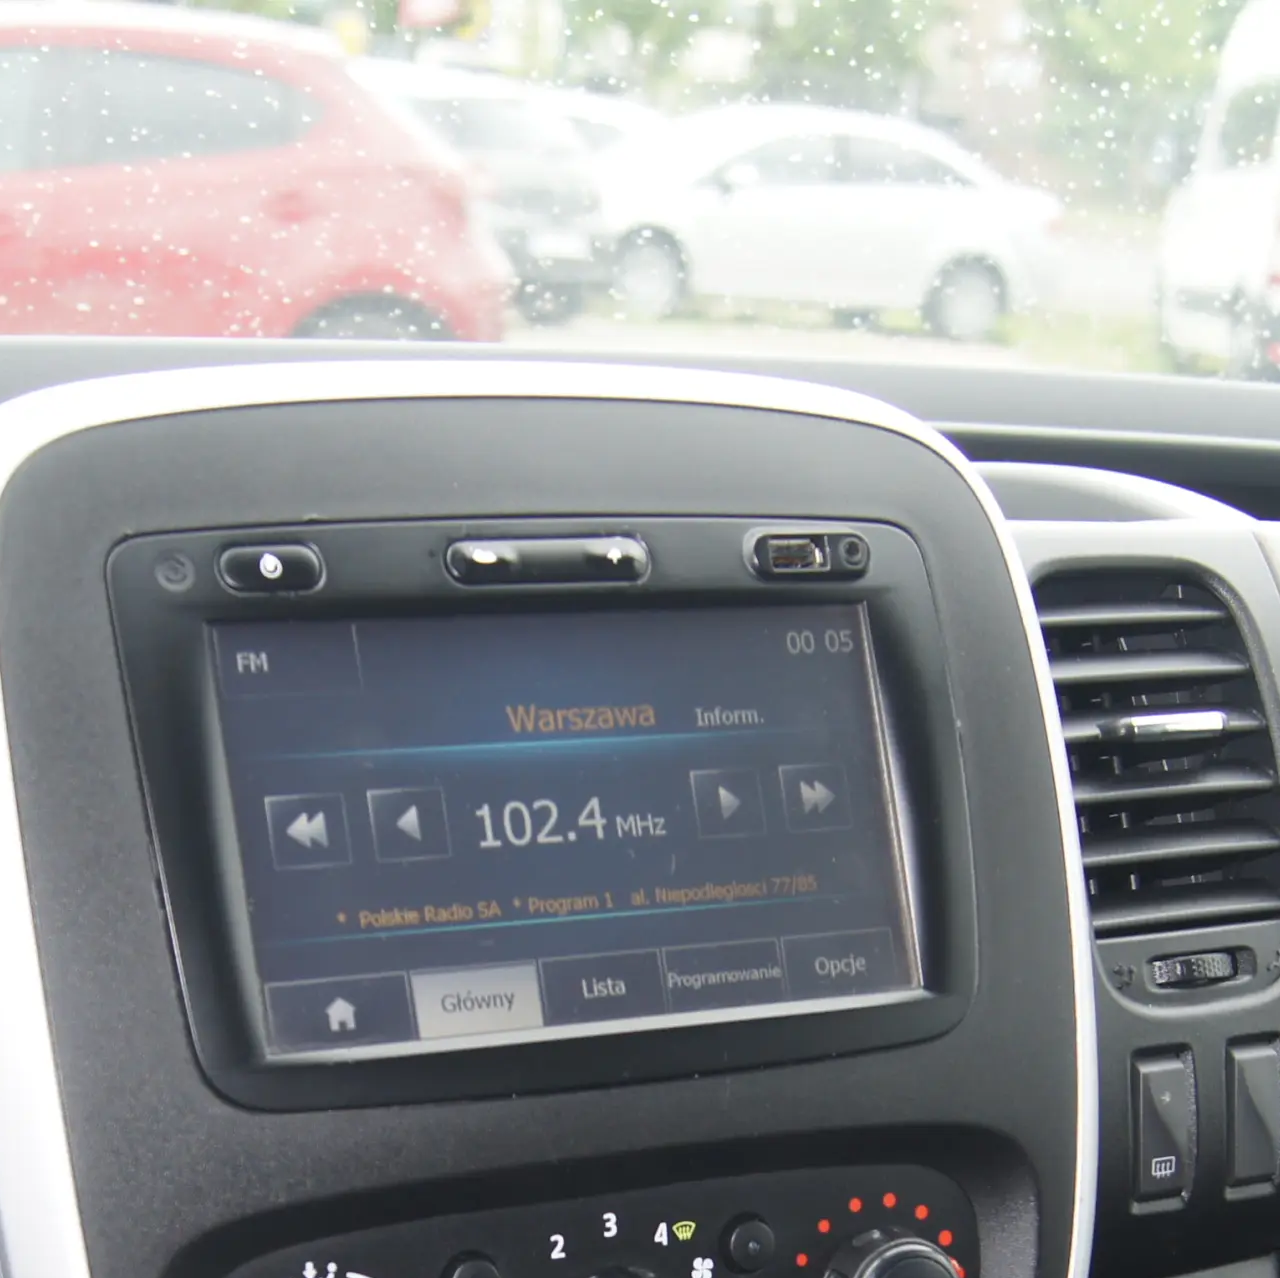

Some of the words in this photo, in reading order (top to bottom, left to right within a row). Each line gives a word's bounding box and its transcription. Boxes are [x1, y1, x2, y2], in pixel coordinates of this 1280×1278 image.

[785, 630, 815, 654] 00
[824, 628, 854, 653] 05
[236, 651, 269, 674] FM
[506, 702, 656, 733] Warszawa
[695, 705, 765, 727] Inform.
[475, 796, 607, 849] 102.4
[615, 813, 667, 838] MHz
[358, 906, 420, 929] Polskie
[423, 902, 474, 924] Radio
[477, 899, 502, 919] SA
[527, 893, 600, 915] Program
[667, 962, 783, 990] Programowanie
[813, 954, 868, 978] Opcje
[581, 976, 627, 999] Lista
[440, 990, 516, 1016] Główny
[602, 1212, 618, 1238] 3
[653, 1222, 669, 1246] 4
[549, 1234, 567, 1259] 2
